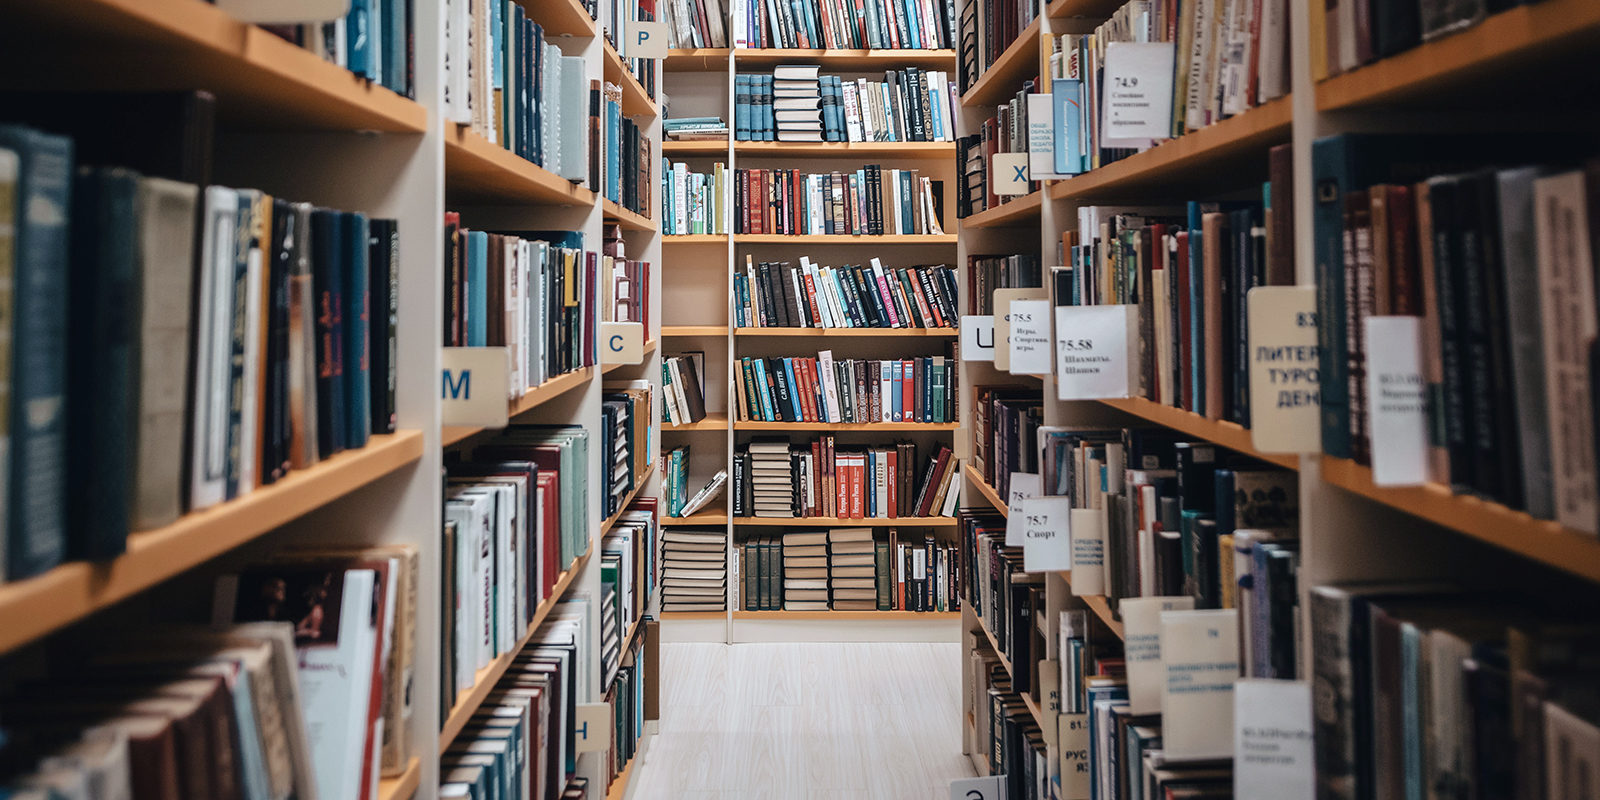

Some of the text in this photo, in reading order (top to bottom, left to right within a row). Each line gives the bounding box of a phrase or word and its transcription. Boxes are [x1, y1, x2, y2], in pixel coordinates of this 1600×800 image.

[638, 31, 650, 46] Р
[1114, 77, 1138, 88] 74.9
[1013, 166, 1027, 182] Х
[1013, 314, 1032, 322] 75.5
[609, 335, 624, 352] С
[1059, 340, 1092, 351] 75.58
[442, 369, 471, 400] М
[1027, 516, 1048, 526] 75.7
[1027, 530, 1056, 539] Спорт
